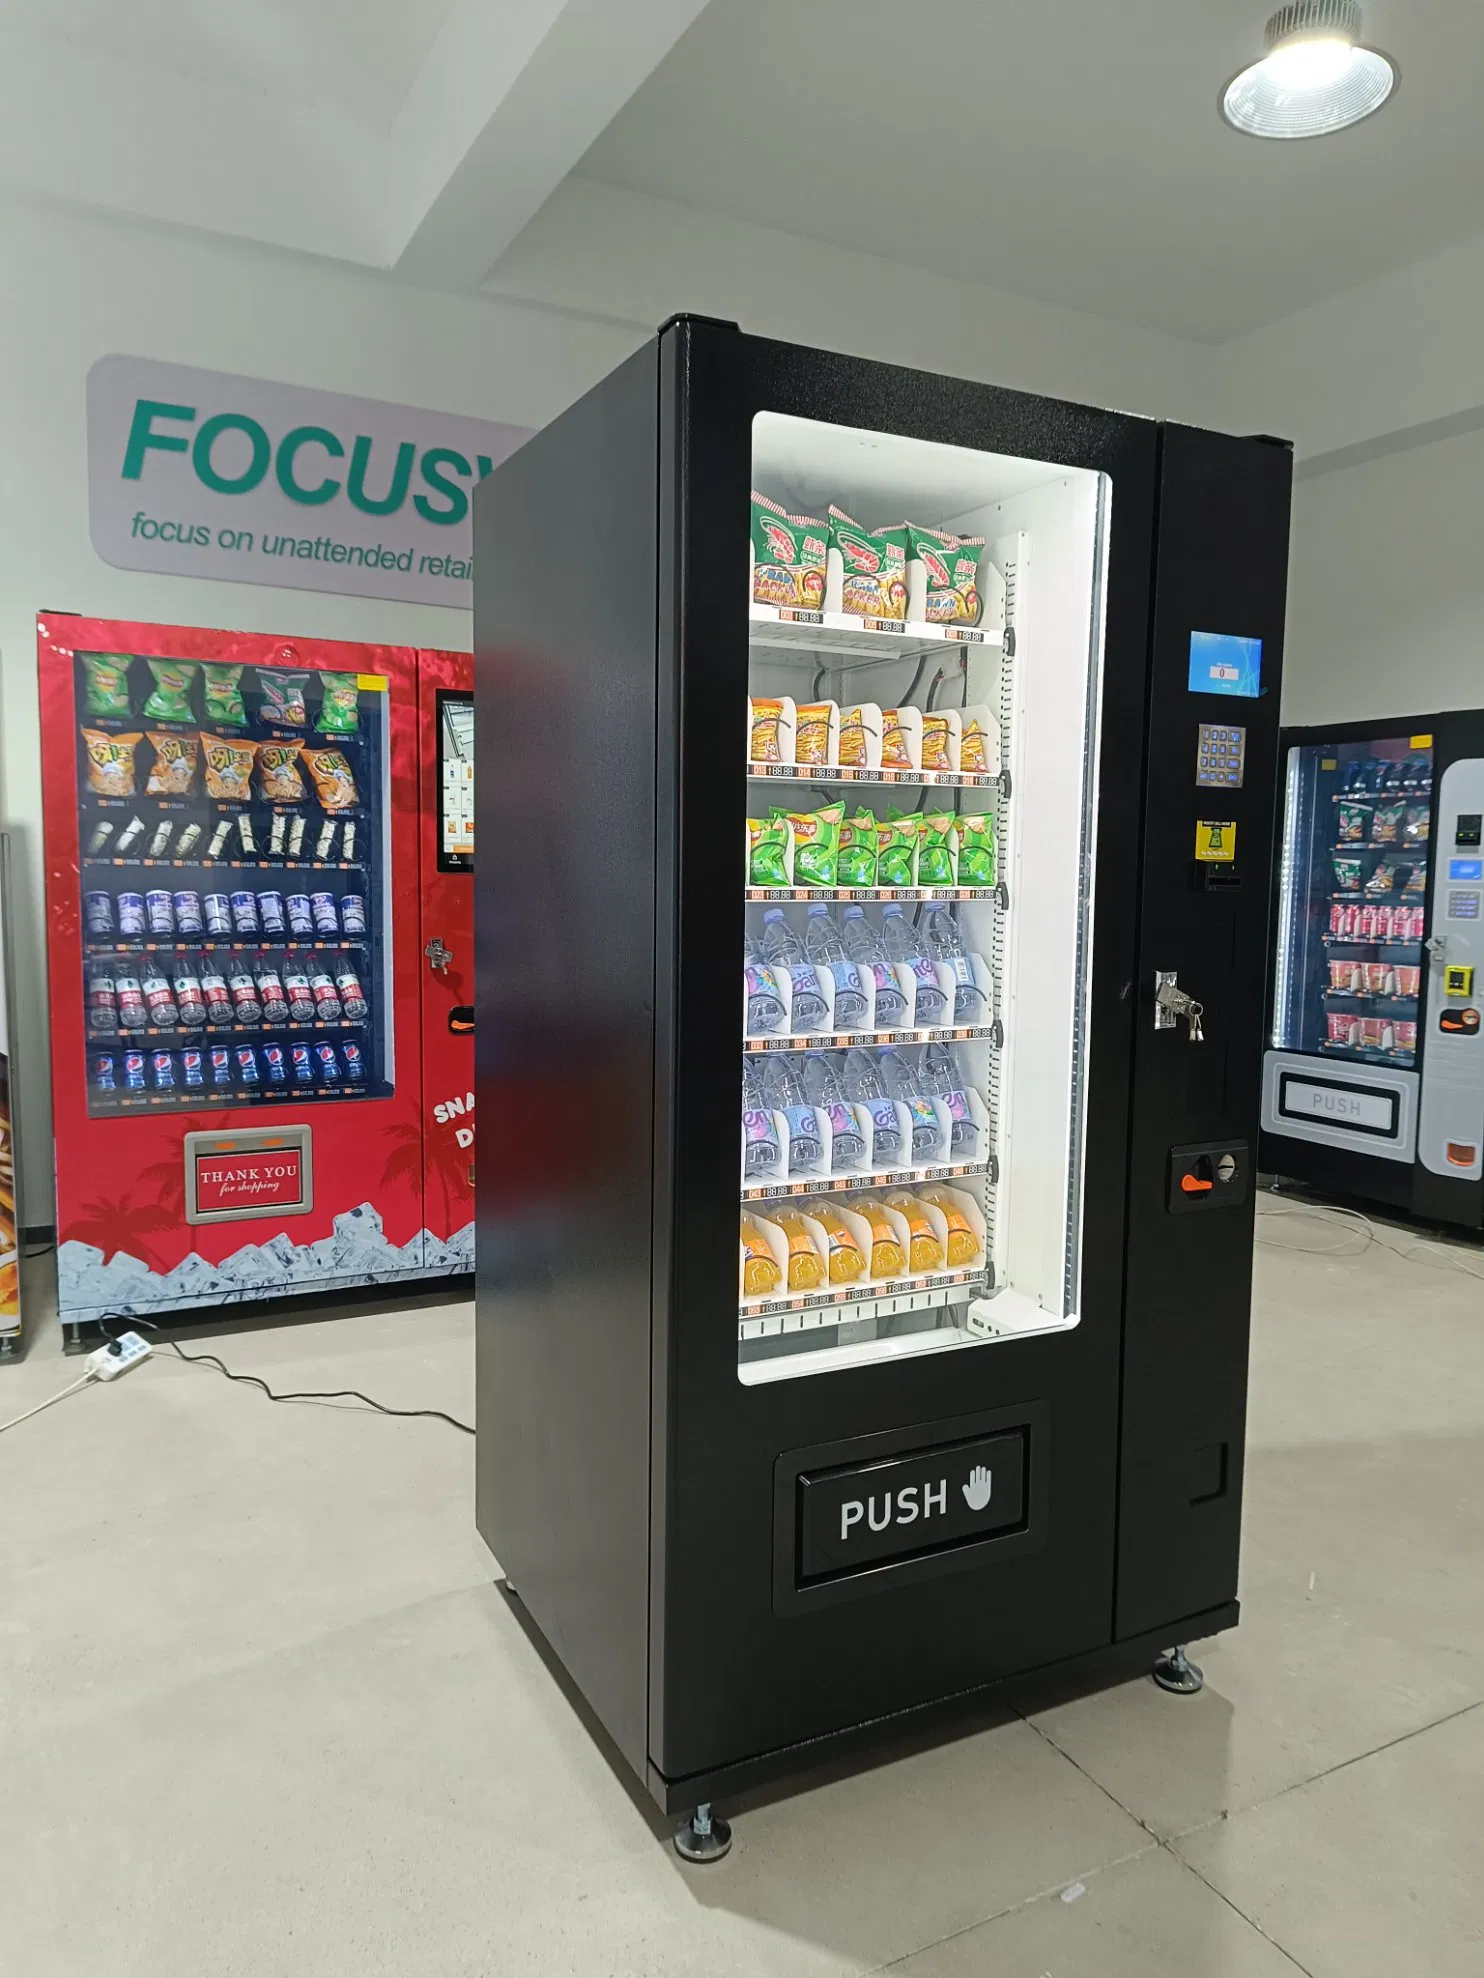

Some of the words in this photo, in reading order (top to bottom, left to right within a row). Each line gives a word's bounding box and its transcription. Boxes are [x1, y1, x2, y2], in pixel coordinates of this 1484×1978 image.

[121, 398, 493, 526] FOCUS
[131, 512, 210, 547] focus
[217, 528, 254, 552] on
[262, 534, 415, 573] unattended
[1219, 668, 1225, 678] 0
[1312, 1093, 1361, 1116] PUSH
[455, 1123, 475, 1148] D
[200, 1168, 260, 1183] THANK
[264, 1165, 297, 1178] YOU
[219, 1182, 236, 1197] for
[237, 1180, 279, 1193] shopping
[841, 1479, 947, 1540] PUSH
